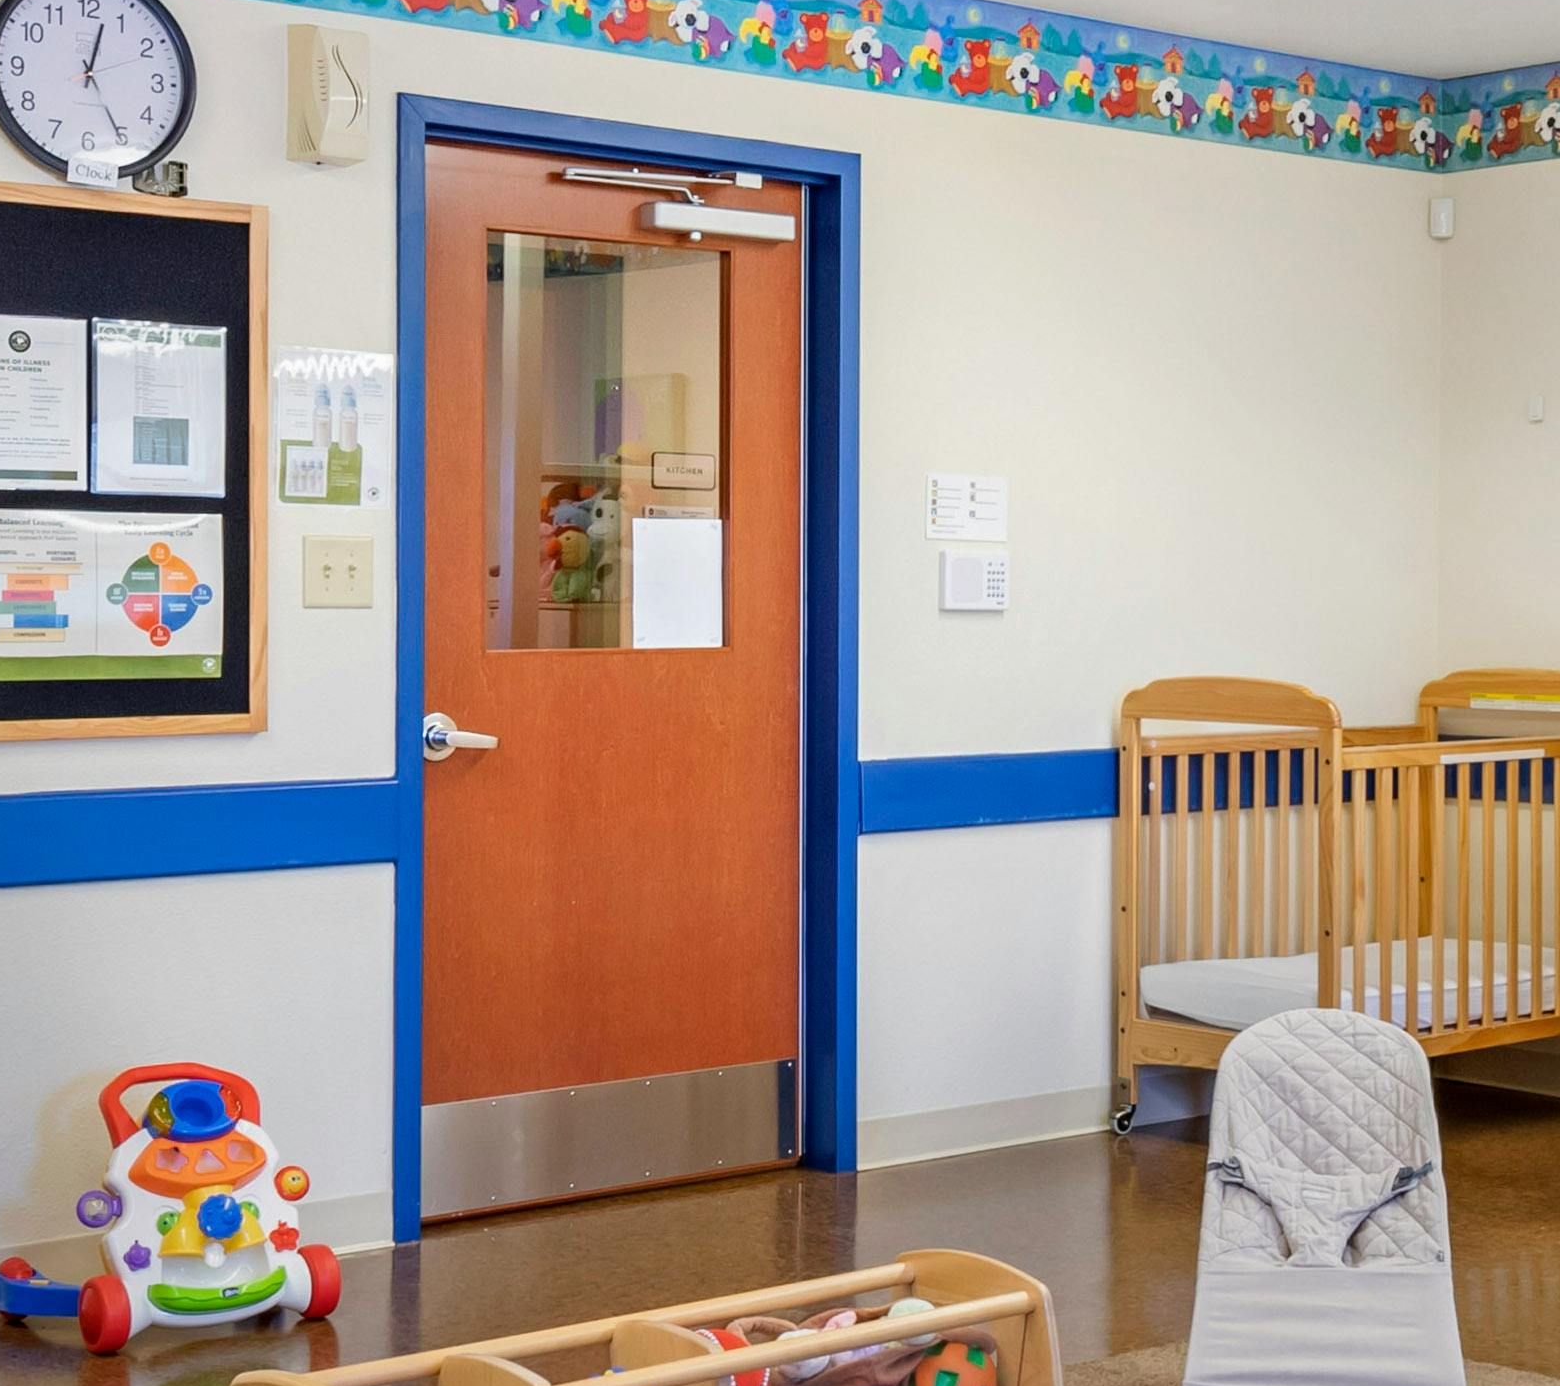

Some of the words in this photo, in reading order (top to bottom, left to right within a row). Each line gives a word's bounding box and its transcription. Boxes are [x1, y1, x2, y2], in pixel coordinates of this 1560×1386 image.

[43, 3, 64, 26] 11
[116, 13, 125, 34] 1
[20, 21, 44, 44] 10
[139, 38, 154, 58] 2
[10, 55, 25, 76] 9
[150, 73, 165, 94] 3
[20, 90, 36, 111] 8
[139, 105, 154, 125] 4
[48, 118, 63, 139] 7
[114, 126, 129, 146] 5
[81, 131, 95, 151] 6
[75, 166, 113, 182] Clock
[7, 365, 43, 373] CHILDREN
[665, 466, 704, 476] KITCHEN
